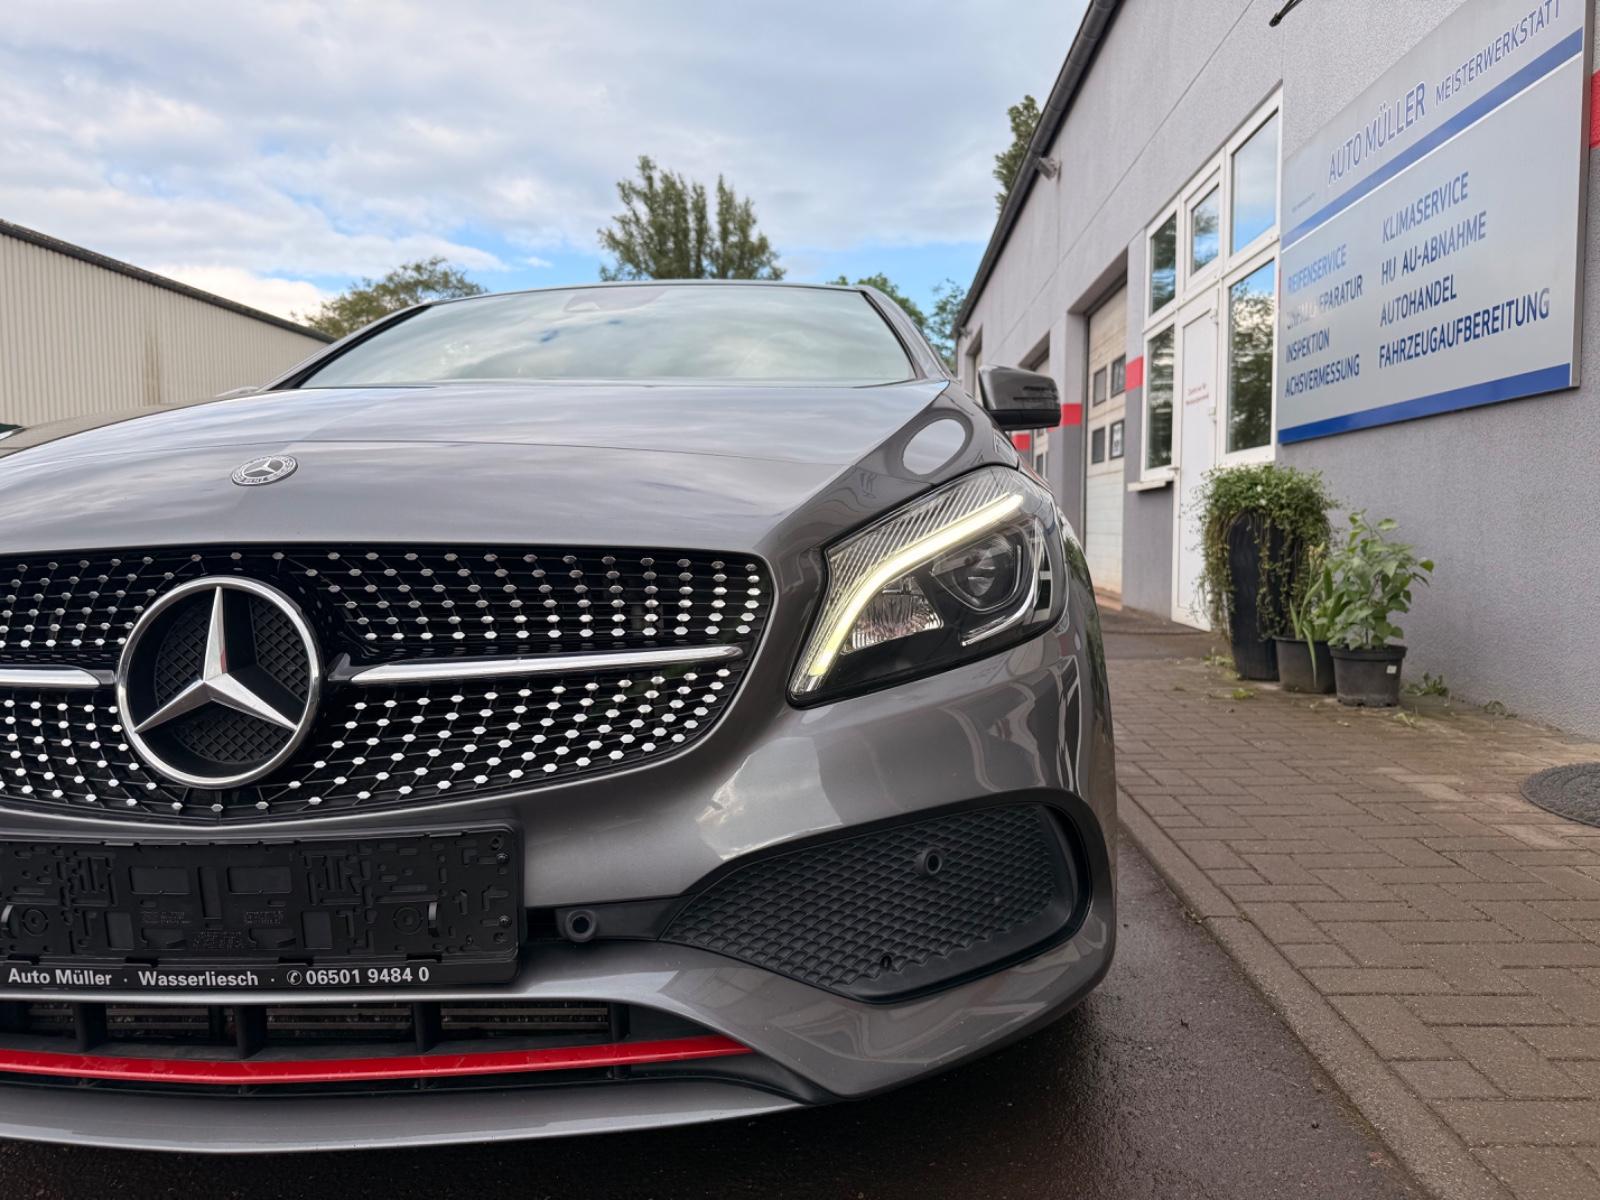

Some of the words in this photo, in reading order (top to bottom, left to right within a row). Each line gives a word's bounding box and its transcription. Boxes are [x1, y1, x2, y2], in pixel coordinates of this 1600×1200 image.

[1327, 132, 1361, 185] AUTO
[1364, 82, 1425, 159] MÜLLER
[1435, 0, 1560, 106] MEISTERWERKSTATT
[1382, 171, 1469, 244] KLIMASERVICE
[1287, 243, 1347, 294] REIFENSERVICE
[1381, 256, 1397, 286] HU
[1401, 210, 1487, 276] AU-ABNAHME
[1379, 274, 1457, 327] AUTOHANDEL
[1286, 326, 1330, 363] INSPEKTION
[1378, 287, 1550, 369] FAHRZEUGAUFBEREITUNG
[1285, 353, 1360, 398] ACHSVERMESSUNG
[8, 967, 50, 984] Auto
[55, 969, 112, 986] Müller
[138, 970, 258, 986] Wasserliesch
[305, 969, 361, 985] 06501
[367, 967, 413, 984] 9484
[418, 966, 430, 982] 0
